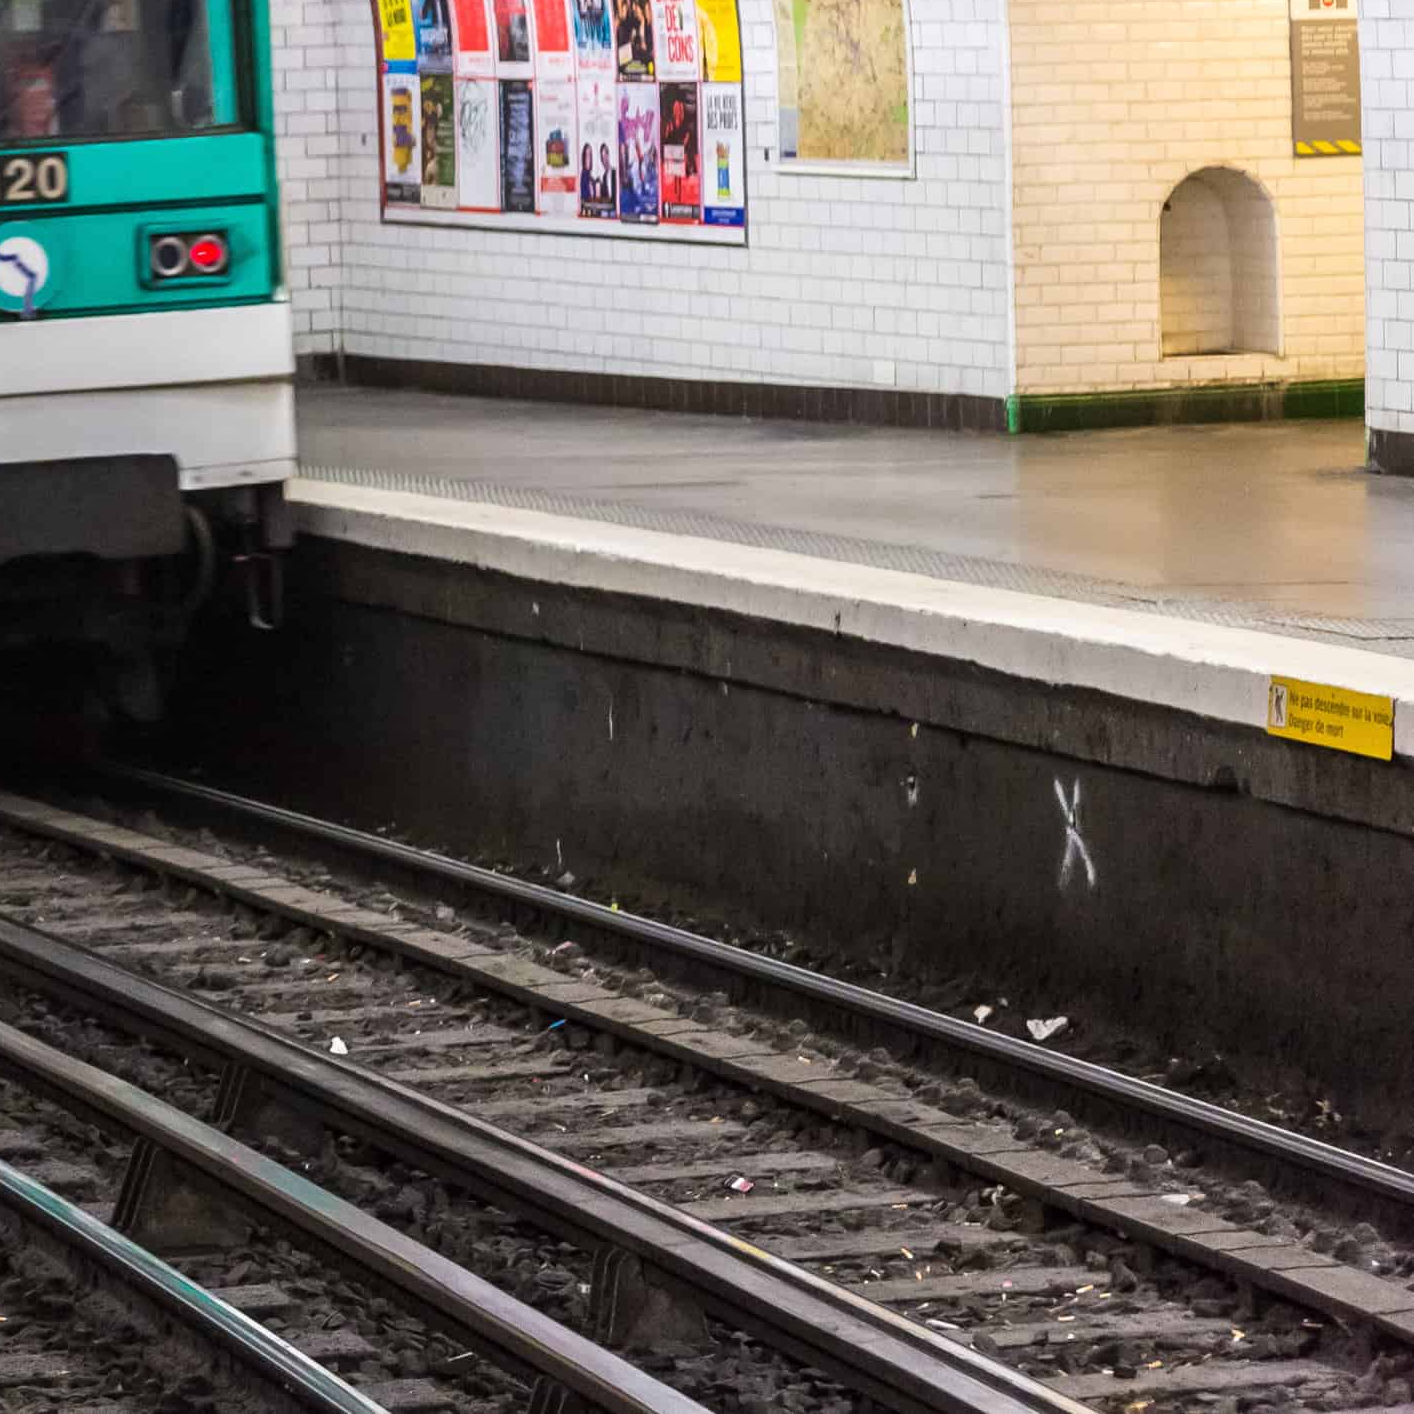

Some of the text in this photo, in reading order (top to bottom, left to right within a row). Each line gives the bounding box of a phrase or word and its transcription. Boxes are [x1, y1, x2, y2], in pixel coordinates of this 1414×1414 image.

[1300, 695, 1313, 712] pas
[1288, 714, 1314, 734] Danger
[1315, 719, 1325, 734] de
